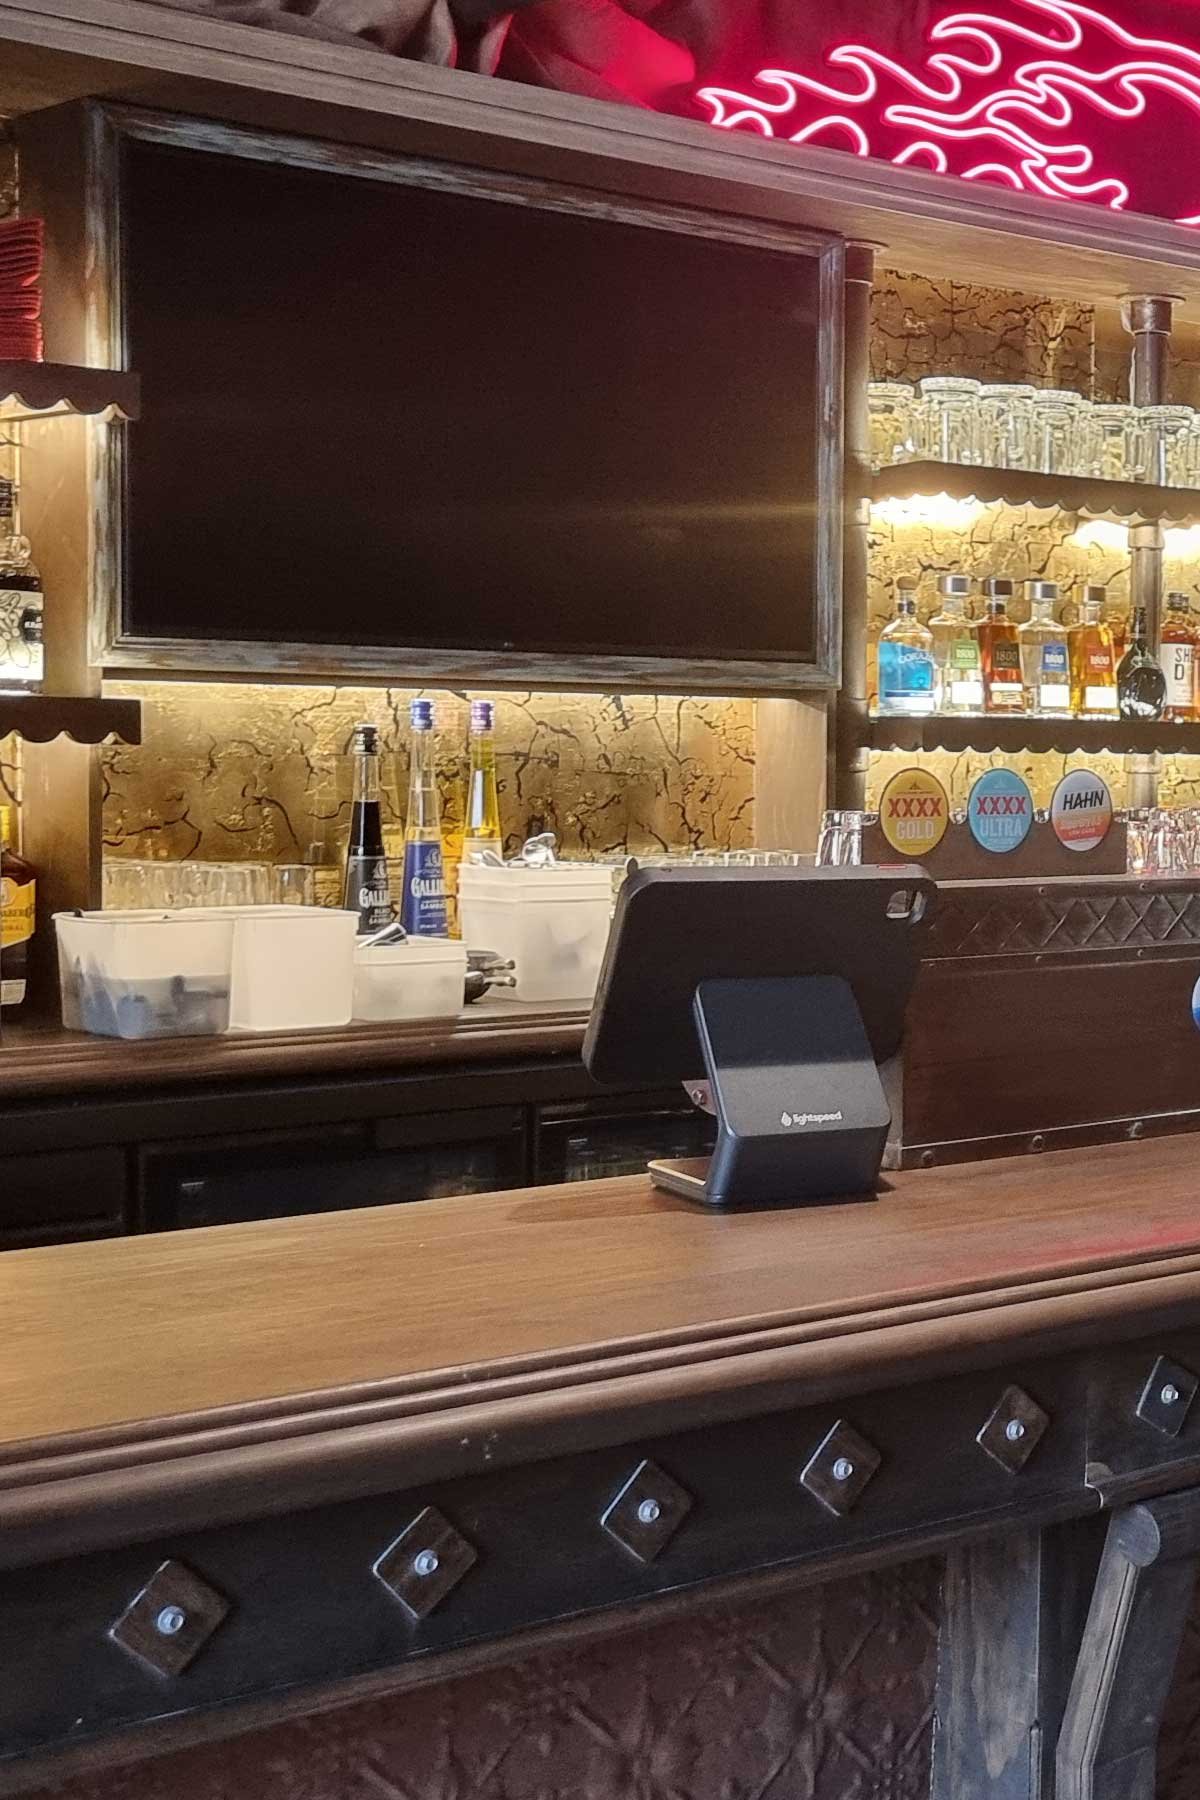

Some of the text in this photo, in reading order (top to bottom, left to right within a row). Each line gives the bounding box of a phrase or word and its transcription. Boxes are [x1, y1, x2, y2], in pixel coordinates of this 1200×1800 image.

[996, 649, 1018, 661] 1800
[1090, 655, 1110, 666] 1800
[888, 797, 942, 818] XXXX
[976, 796, 1026, 815] XXXX
[1063, 789, 1105, 810] HAHN
[896, 821, 935, 839] GOLD
[980, 818, 1022, 836] ULTRA
